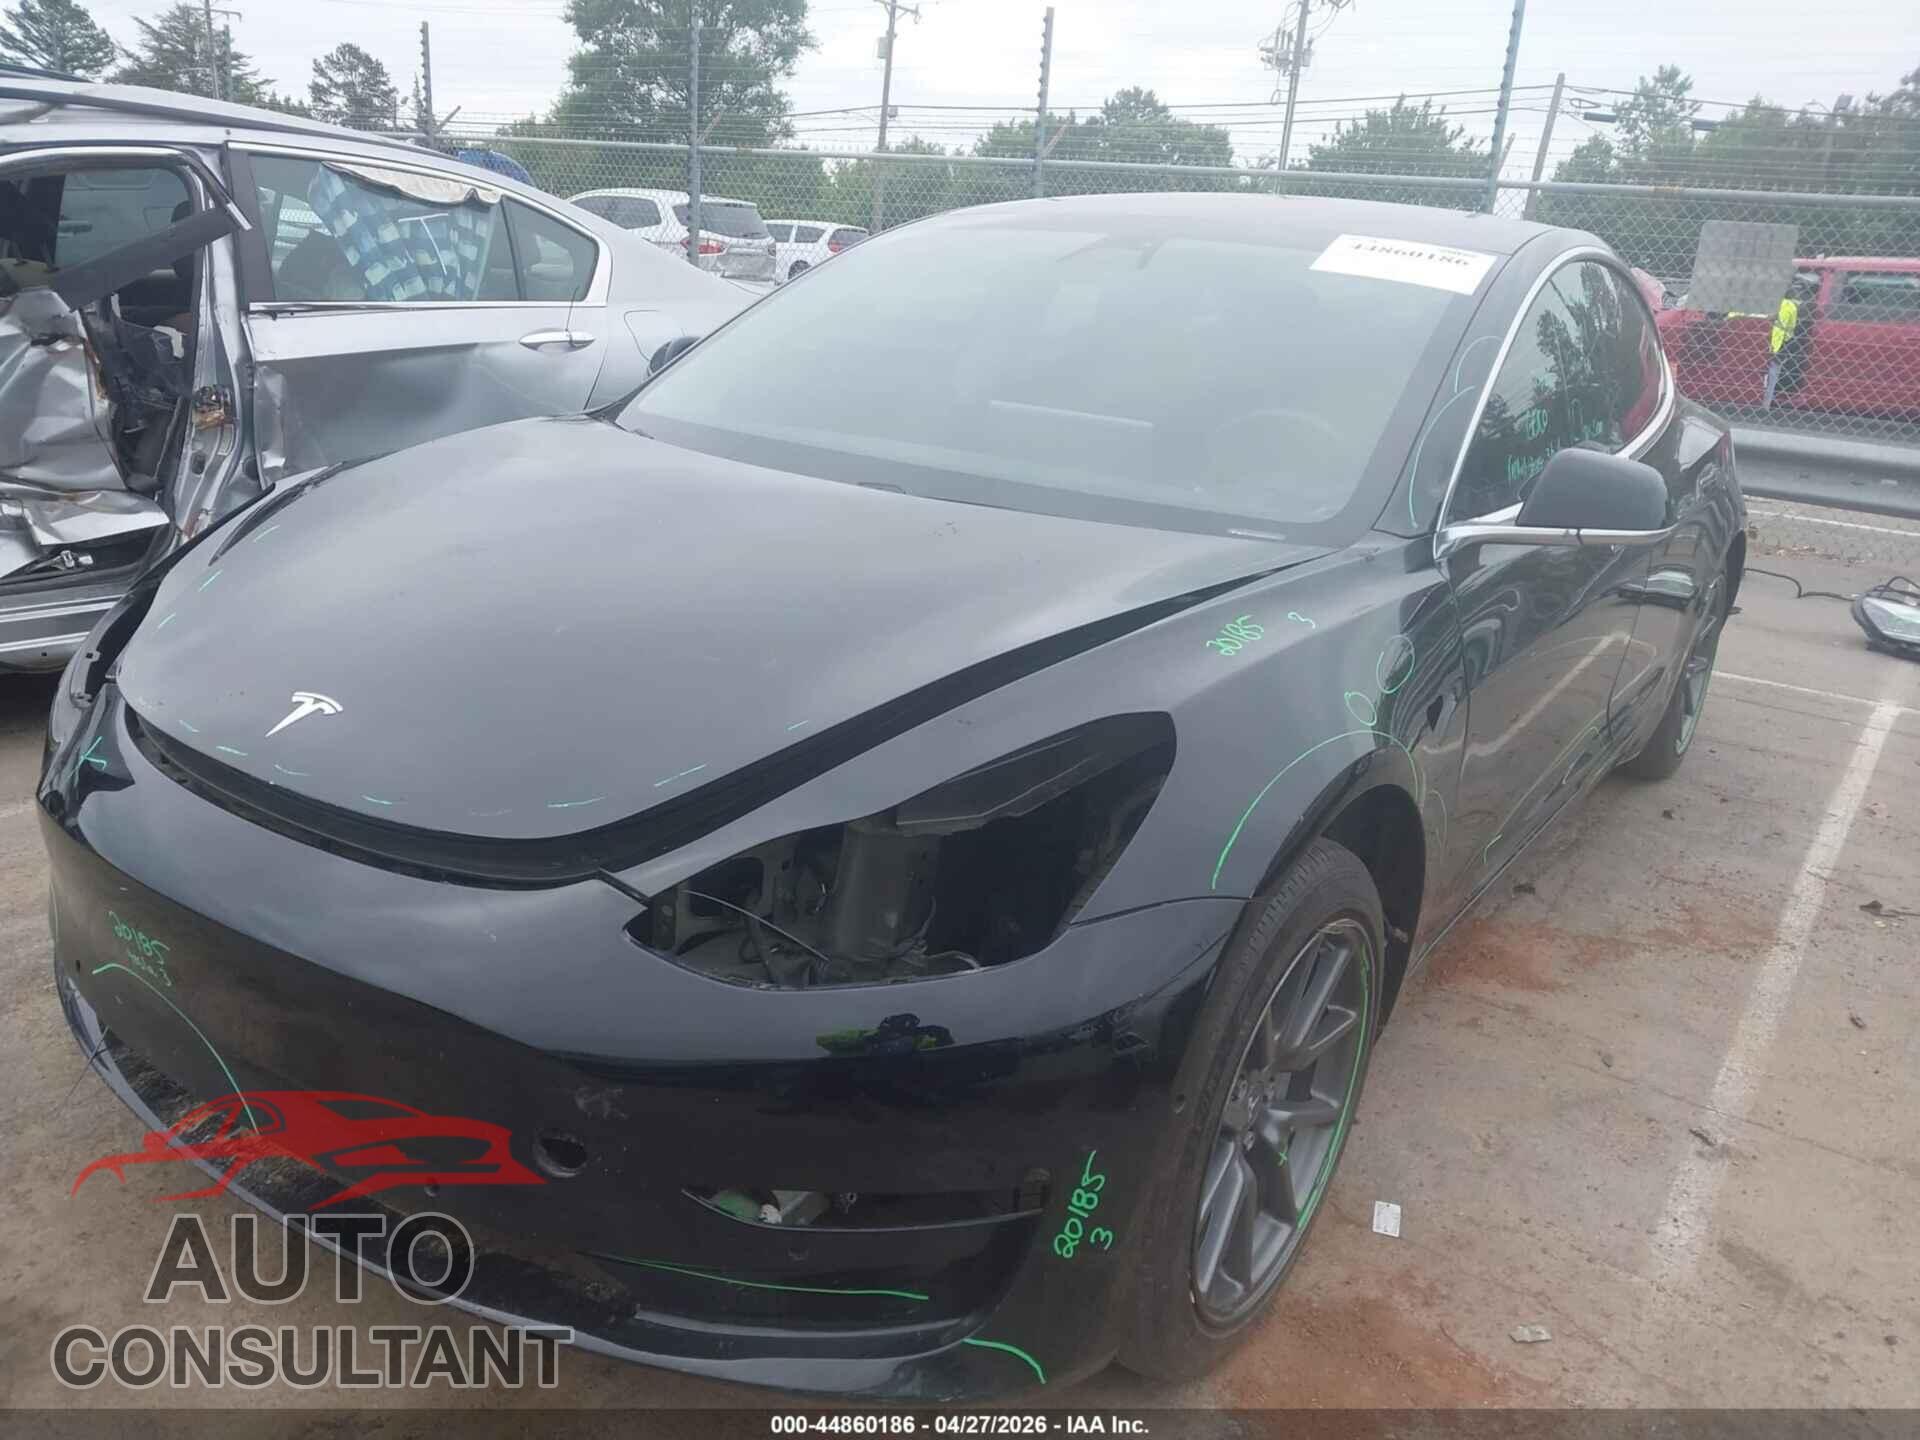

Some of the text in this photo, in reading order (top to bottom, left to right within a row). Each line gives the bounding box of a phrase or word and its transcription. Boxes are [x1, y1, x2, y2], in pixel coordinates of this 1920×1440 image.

[1206, 614, 1264, 656] 20185
[1054, 1150, 1105, 1258] 20185
[1090, 1227, 1113, 1250] 3
